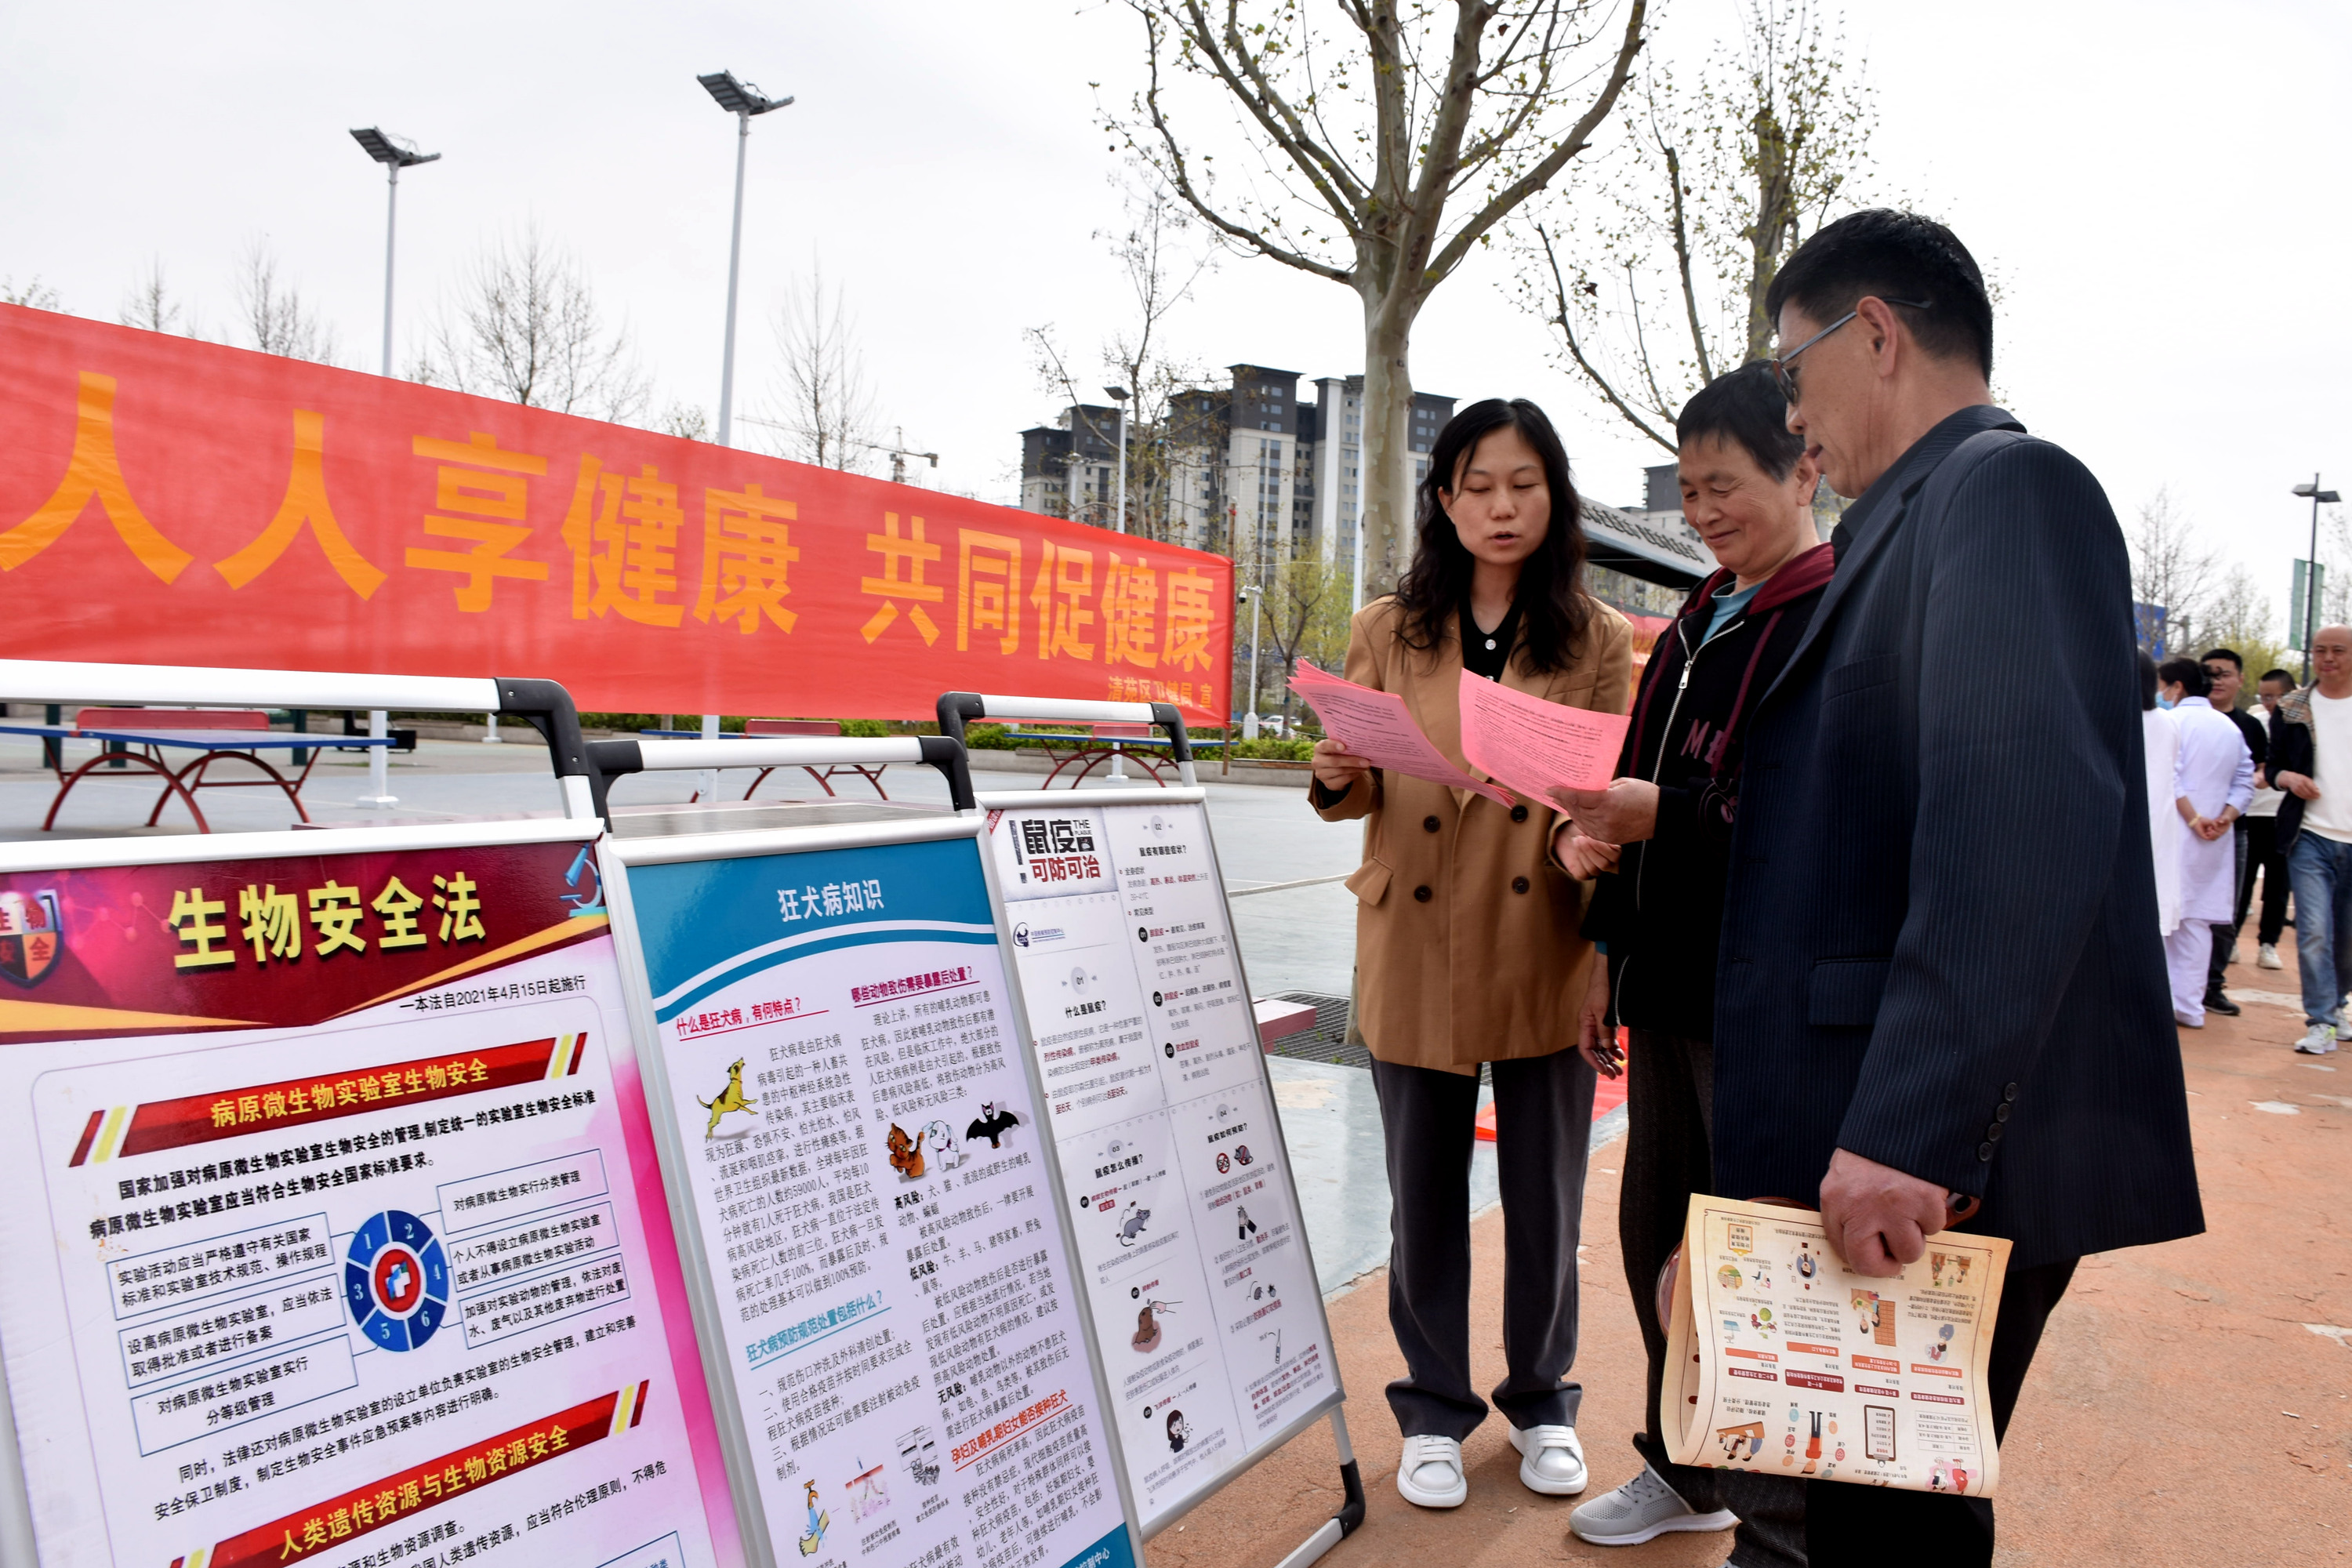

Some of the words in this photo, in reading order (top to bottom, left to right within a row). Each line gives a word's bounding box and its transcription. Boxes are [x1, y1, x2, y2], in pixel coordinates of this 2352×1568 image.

[0, 371, 800, 635] 人人享健康
[860, 511, 1216, 673] 共同促健康
[1199, 683, 1213, 708] 宣
[1020, 818, 1077, 855] 鼠疫
[1073, 819, 1091, 829] THE
[1029, 854, 1102, 884] 可防可治
[168, 871, 486, 968] 生物安全法
[775, 878, 886, 923] 狂犬病知识
[1133, 906, 1154, 917] 常见类型
[1076, 975, 1084, 985] 01
[674, 995, 802, 1036] 什么是狂犬病，有何特点？
[757, 1053, 848, 1087] 病毒引起的一种人畜共
[768, 1033, 842, 1062] 狂犬病是由狂犬病
[210, 1057, 489, 1128] 病原微生物实验室生物安全
[760, 1071, 852, 1106] 患的中枢神经系统急性
[764, 1089, 855, 1125] 传染病。其主要临床表
[452, 1170, 582, 1212] 对病原微生物实行分类管理
[713, 1142, 869, 1203] 世界卫生组织最新数据，全球每年因狂
[363, 1233, 372, 1250] 1
[404, 1223, 415, 1240] 2
[452, 1213, 601, 1265] 个人不得设立病原微生物实验室
[726, 1196, 880, 1263] 病高风险地区，狂犬病一直位于法定传
[731, 1214, 884, 1283] 染病死亡人数的前三位。狂犬病一旦发
[117, 1226, 312, 1287] 实验活动应当严格遵守有关国家
[121, 1243, 328, 1308] 标准和实验室技术规范、操作规程
[431, 1263, 441, 1280] 4
[456, 1235, 595, 1286] 或者从事病原微生物实验活动
[934, 1248, 1048, 1309] 被低风险动物致伤后是否进行暴露
[353, 1283, 364, 1300] 3
[463, 1261, 622, 1319] 加强对实验动物的管理，依法对废
[467, 1278, 626, 1338] 水、废气以及其他废弃物进行处置
[127, 1286, 333, 1356] 设高病原微生物实验室，应当依法
[379, 1322, 390, 1340] 5
[419, 1309, 430, 1327] 6
[130, 1325, 273, 1377] 取得批准或者进行备案
[933, 1342, 1000, 1388] 照高风险动物处置。
[156, 1356, 309, 1415] 对病原微生物实验室实行
[762, 1338, 913, 1421] 二、使用合格疫苗并按时间要求完成全
[205, 1390, 276, 1426] 分等级管理
[771, 1374, 920, 1461] 三、根据情况还可能需要注射被动免疫
[950, 1387, 1068, 1466] 孕妇及哺乳期妇女能否接种狂犬
[274, 1421, 570, 1561] 人类遗传资源与生物资源安全
[775, 1457, 800, 1482] 制剂。
